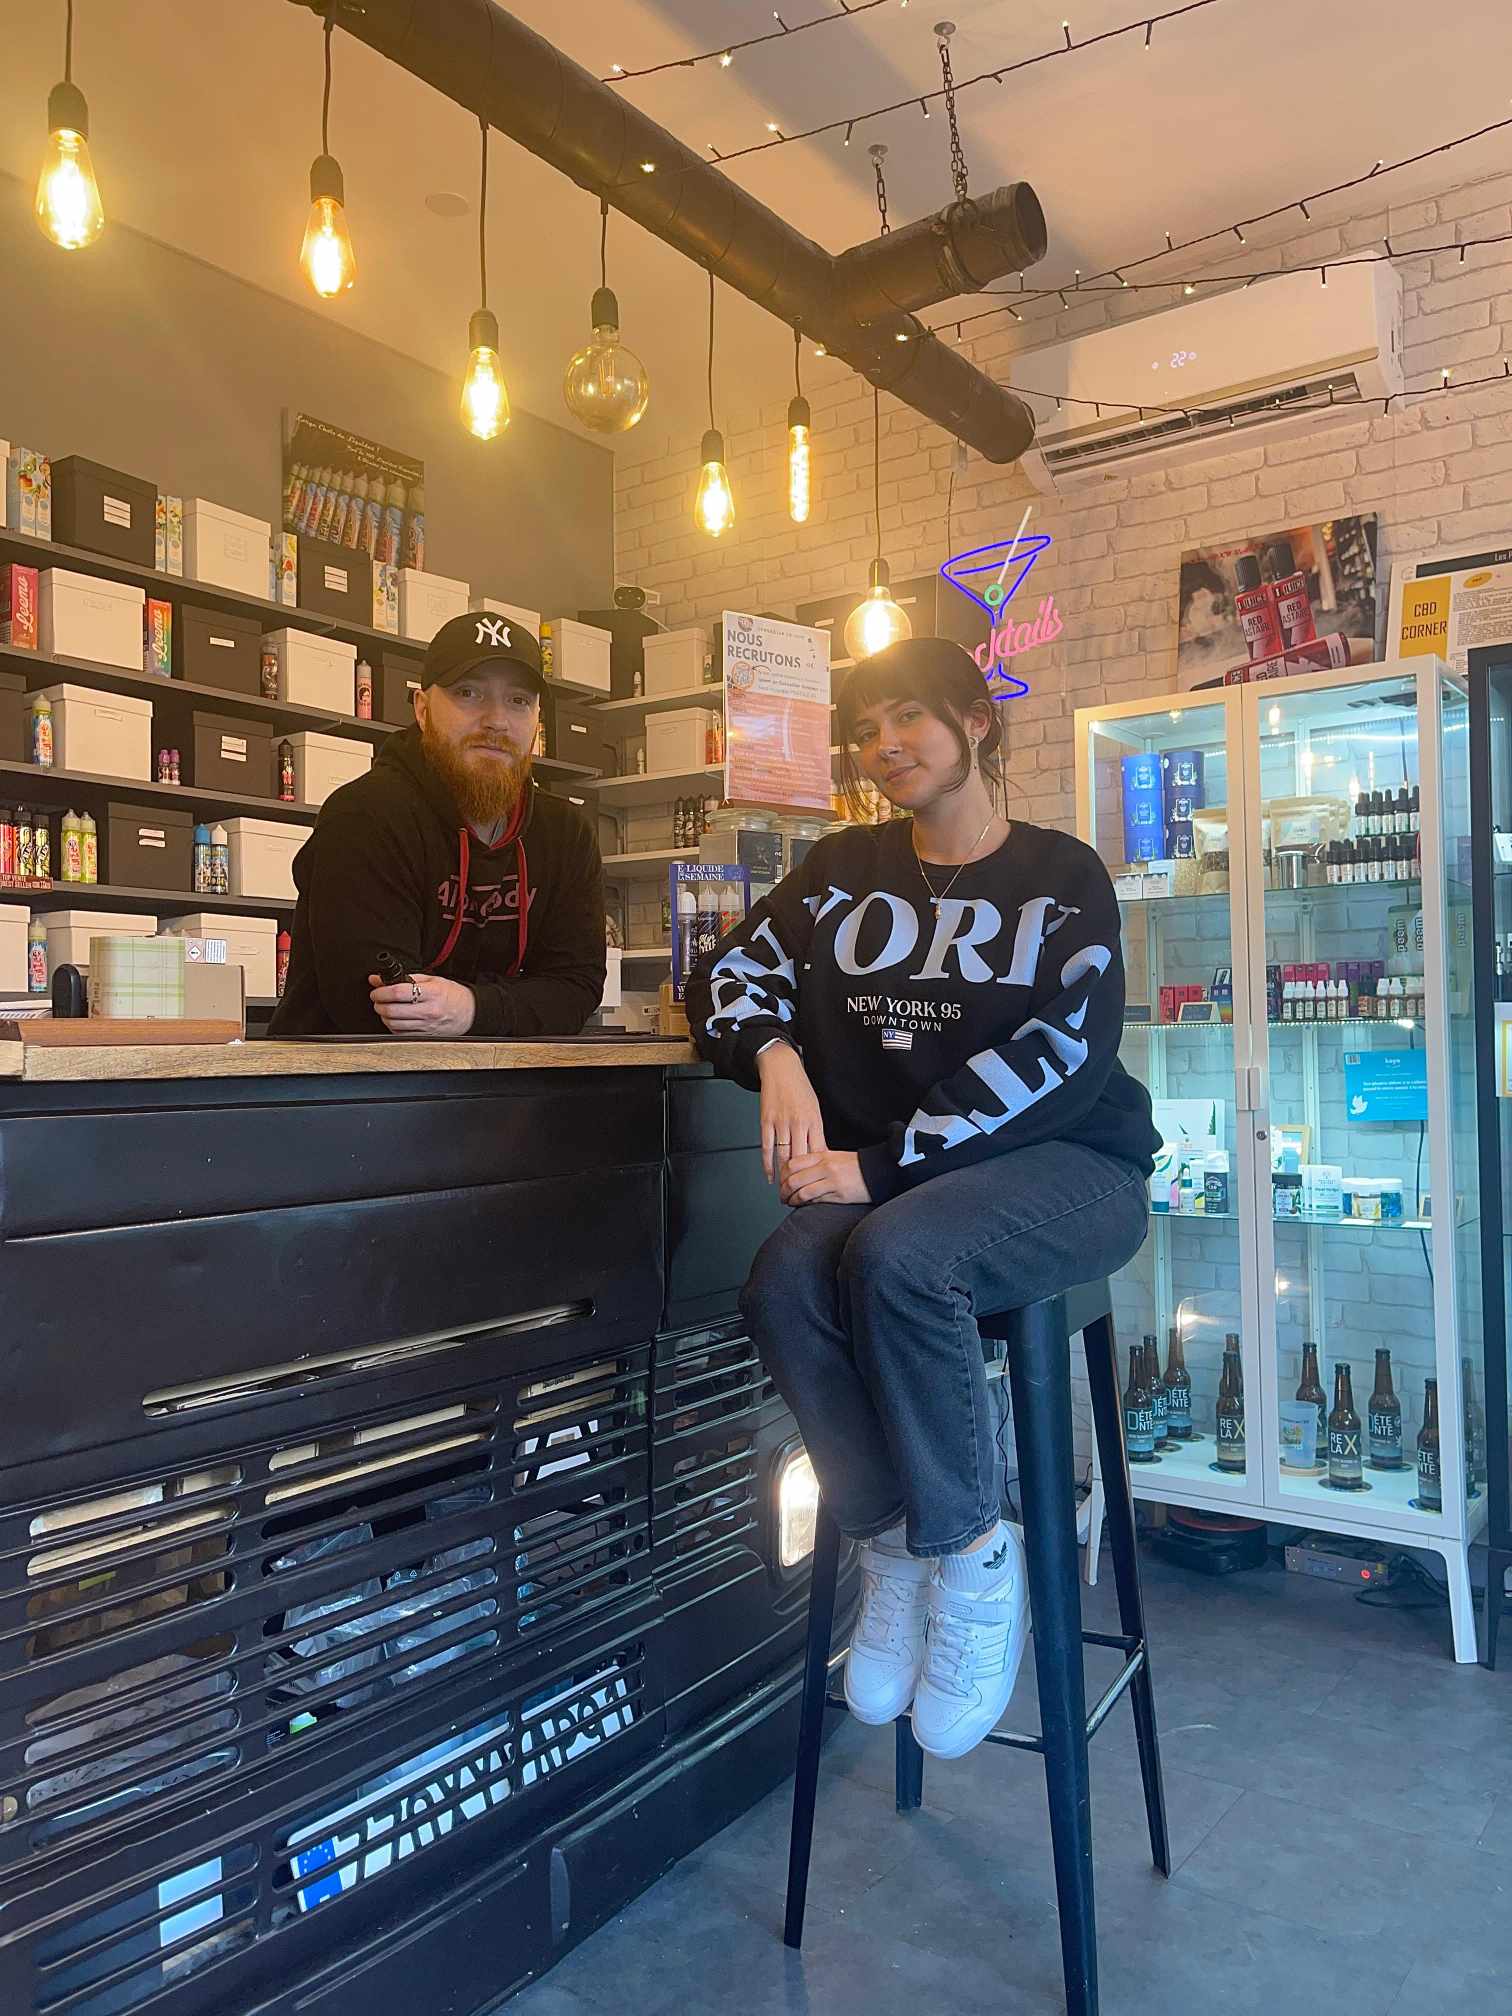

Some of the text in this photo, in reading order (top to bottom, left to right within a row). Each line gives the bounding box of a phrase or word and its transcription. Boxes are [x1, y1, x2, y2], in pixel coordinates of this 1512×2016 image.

[1286, 600, 1302, 613] RED
[1414, 601, 1437, 618] CBD
[475, 617, 511, 648] NY
[727, 629, 763, 647] NOUS
[1401, 620, 1448, 641] CORNER
[727, 645, 801, 669] RECRUTONS
[685, 873, 725, 881] SEMAINE
[847, 995, 961, 1020] NEW YORK 95
[863, 1015, 942, 1032] DOWNTOWN
[883, 1030, 896, 1039] NY
